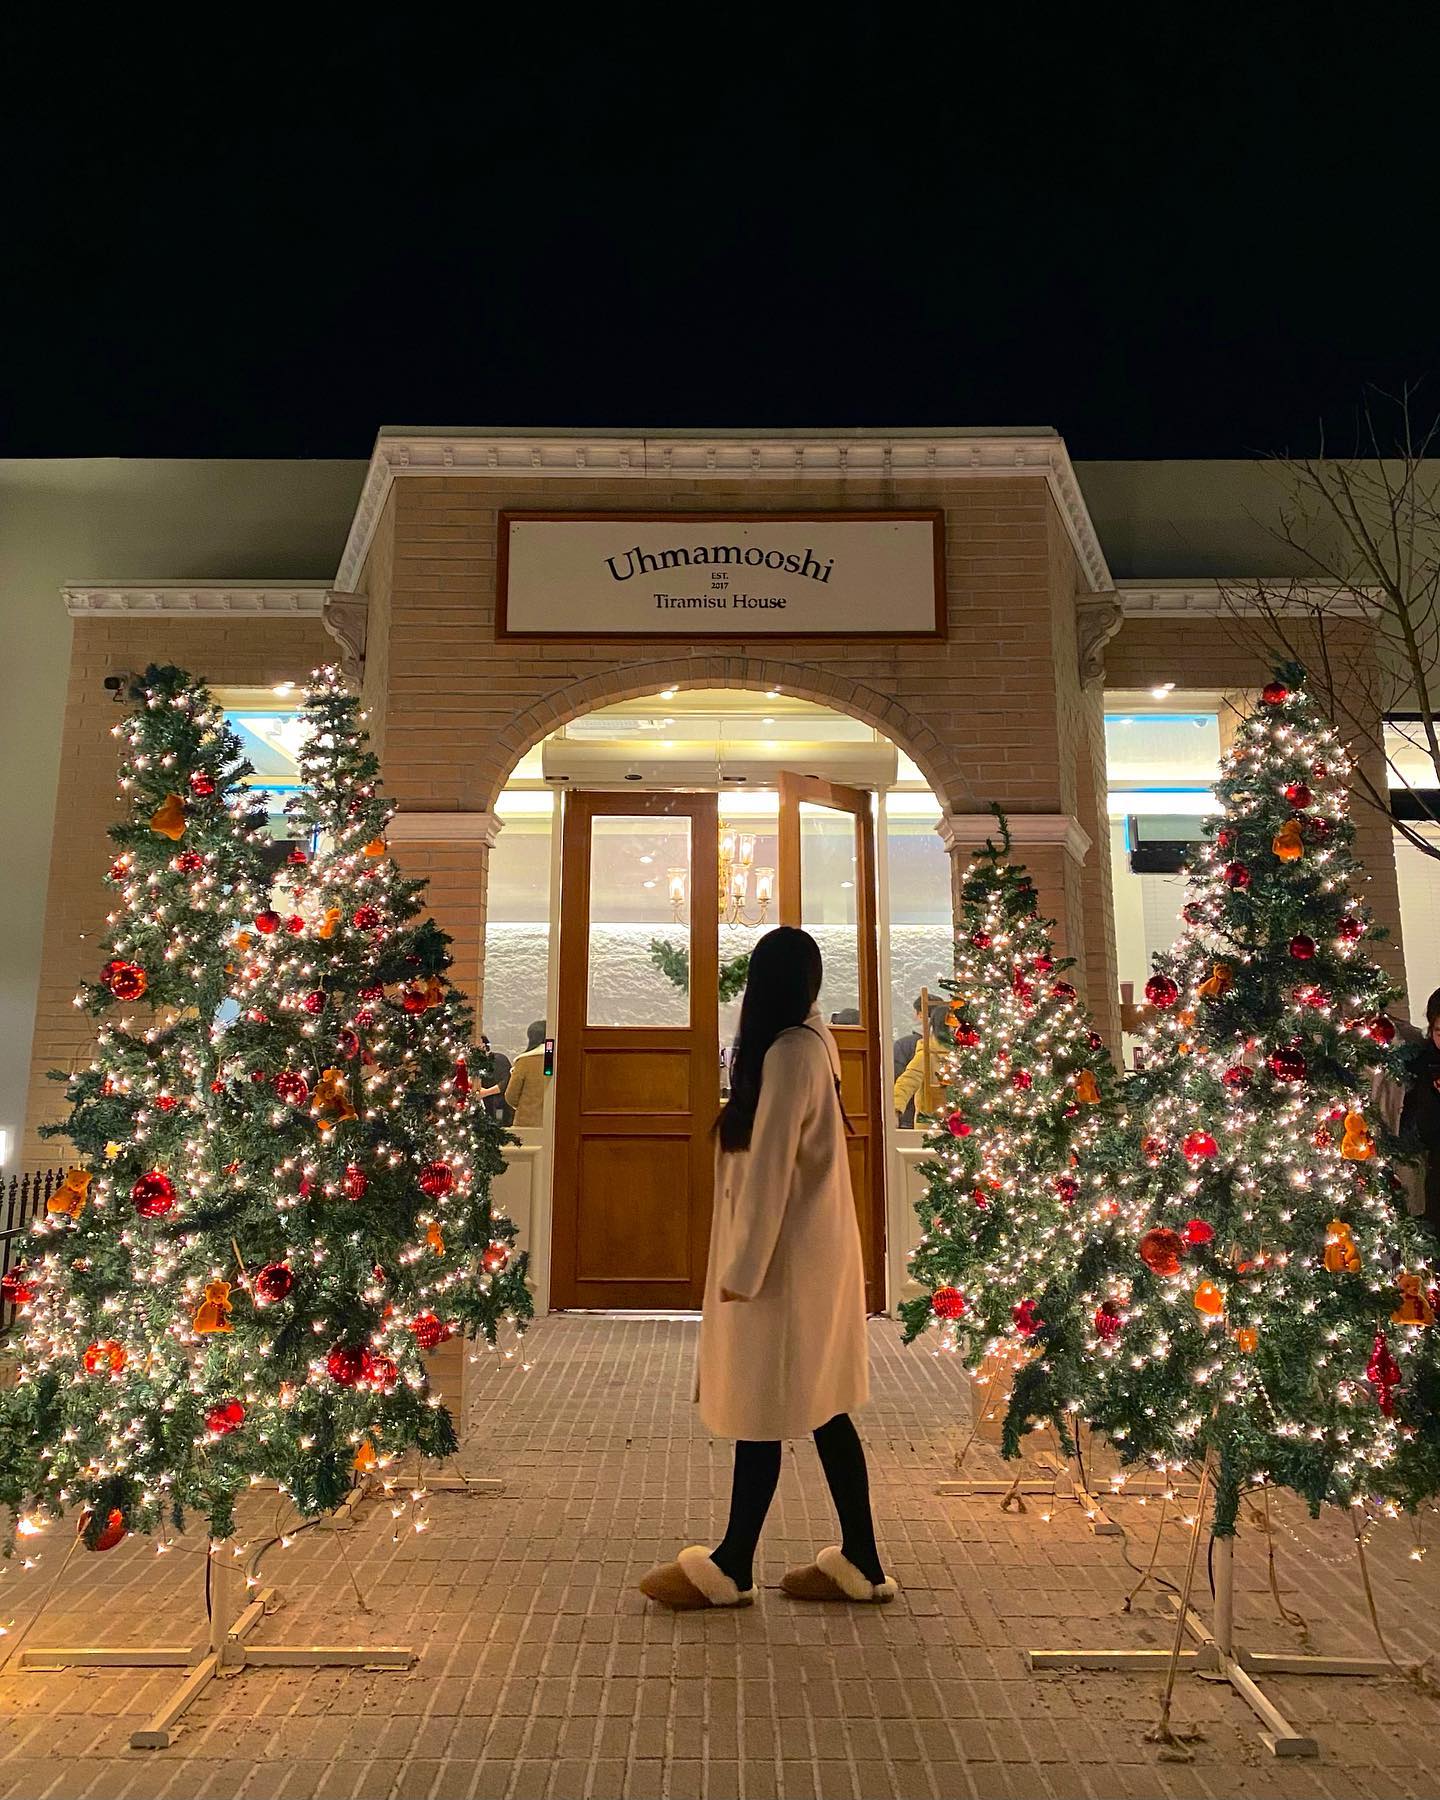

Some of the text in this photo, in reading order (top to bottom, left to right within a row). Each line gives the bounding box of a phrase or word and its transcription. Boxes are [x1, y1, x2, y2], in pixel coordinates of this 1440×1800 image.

[604, 545, 835, 583] Uhmamooshi
[711, 572, 729, 580] EST.
[711, 582, 729, 590] 2017
[653, 593, 787, 609] Tiramisu House
